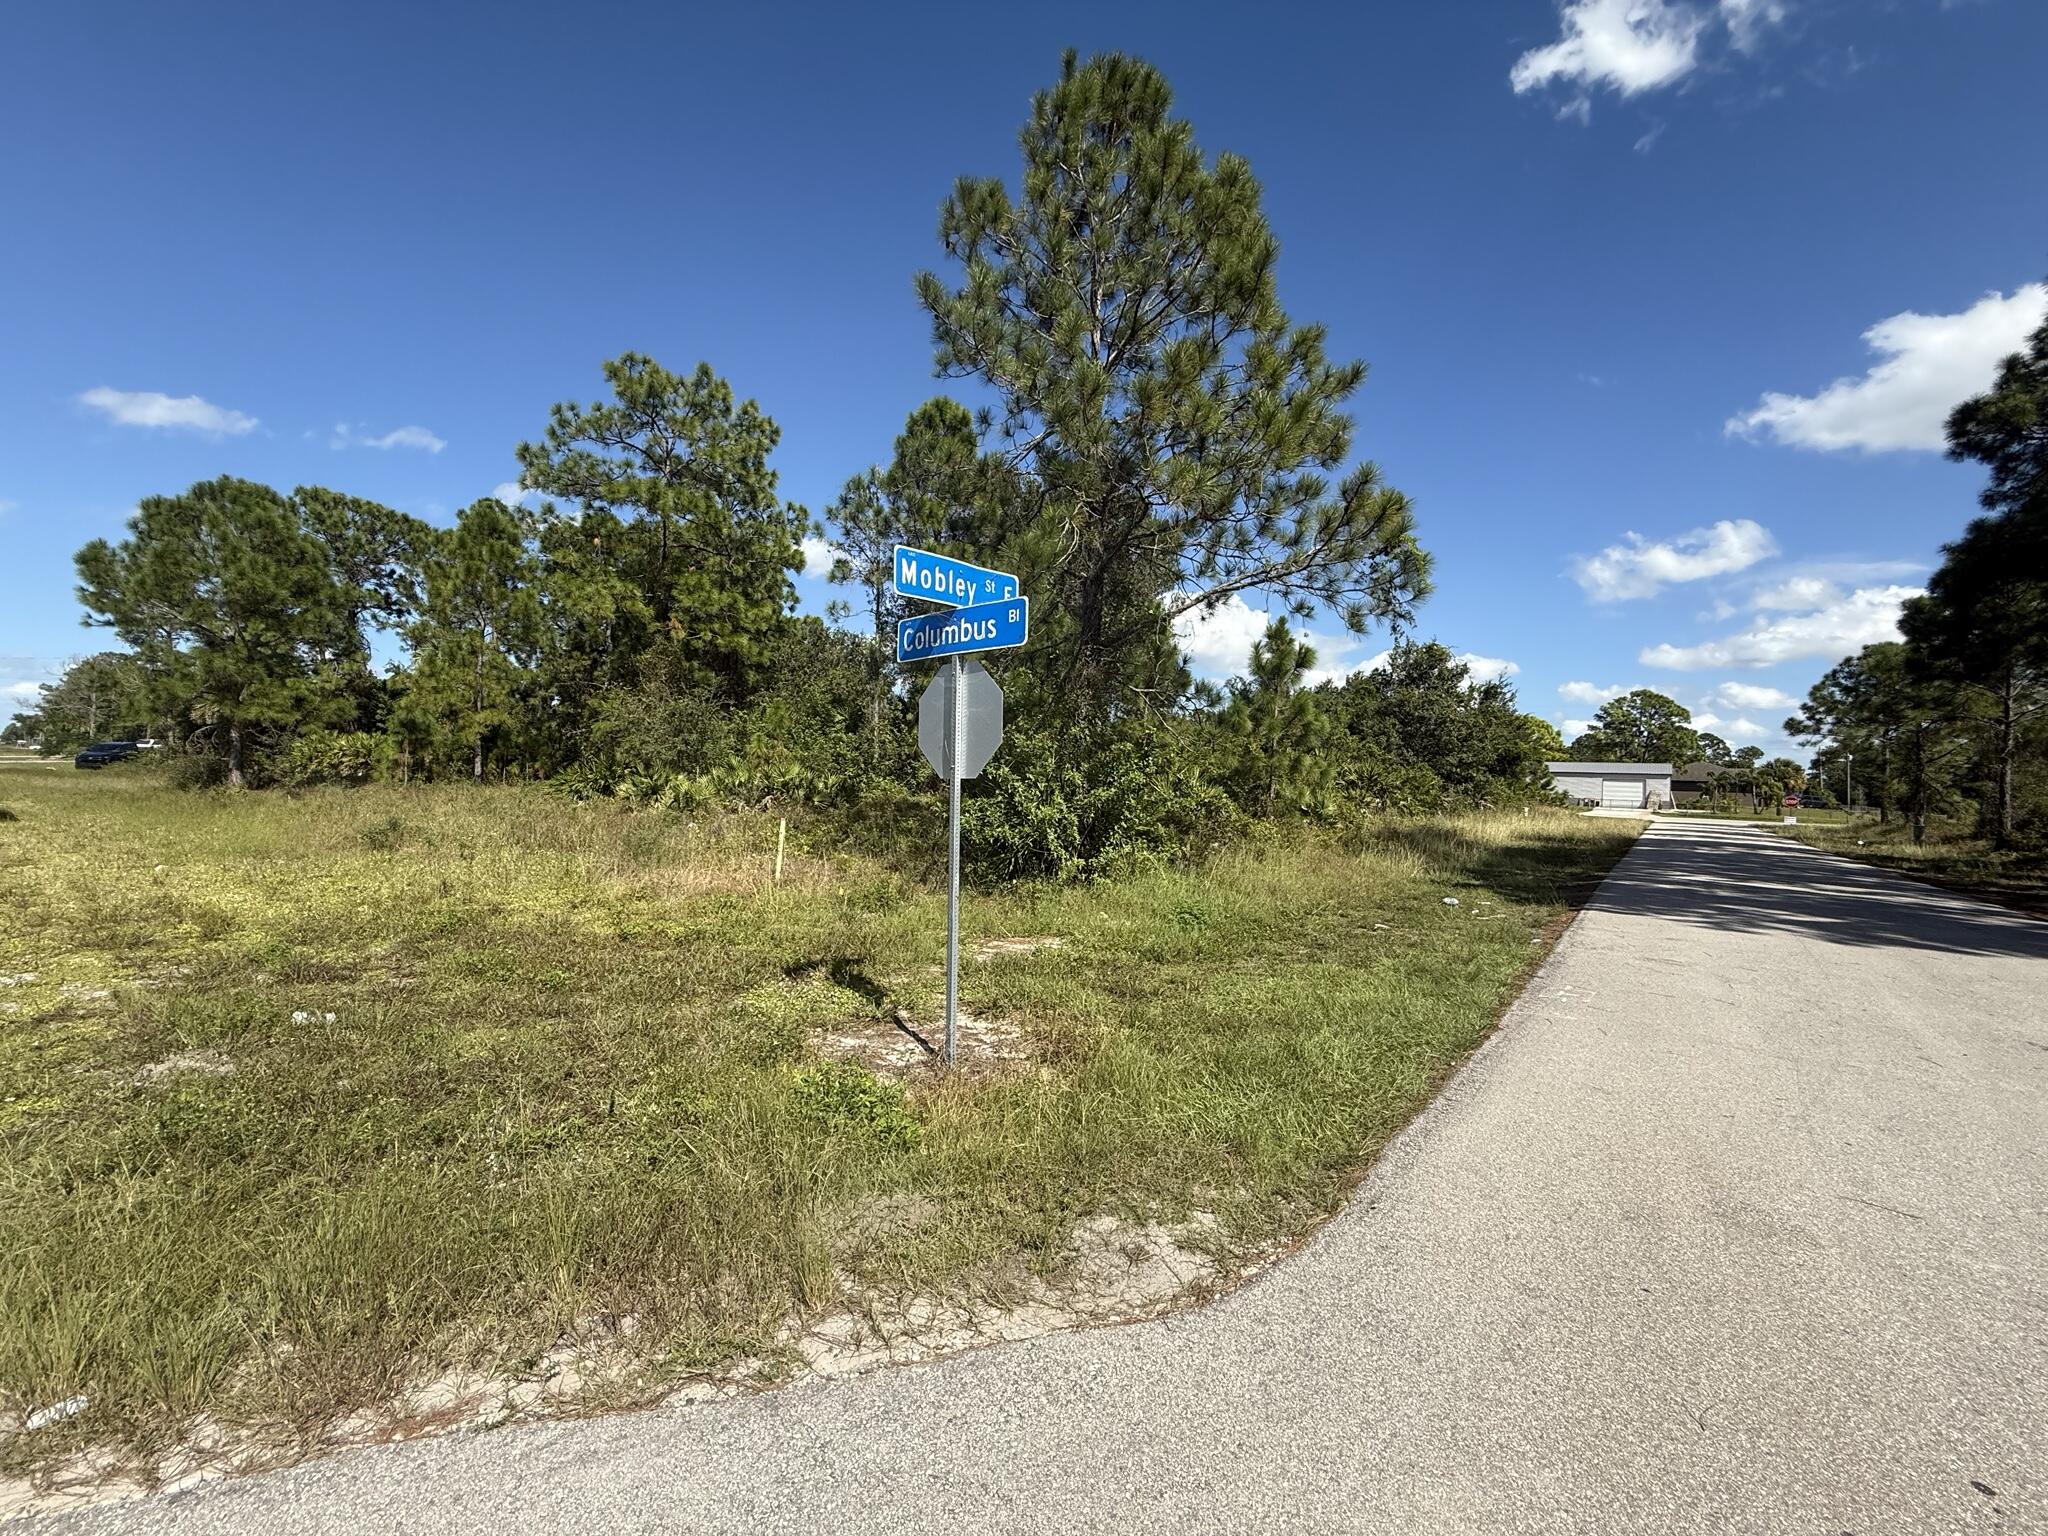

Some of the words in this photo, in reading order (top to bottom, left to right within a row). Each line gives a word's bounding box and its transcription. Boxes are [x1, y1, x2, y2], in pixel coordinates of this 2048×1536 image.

[901, 557, 977, 606] Mobley
[985, 580, 996, 593] St
[903, 617, 997, 651] Columbus
[1008, 609, 1020, 623] Bl
